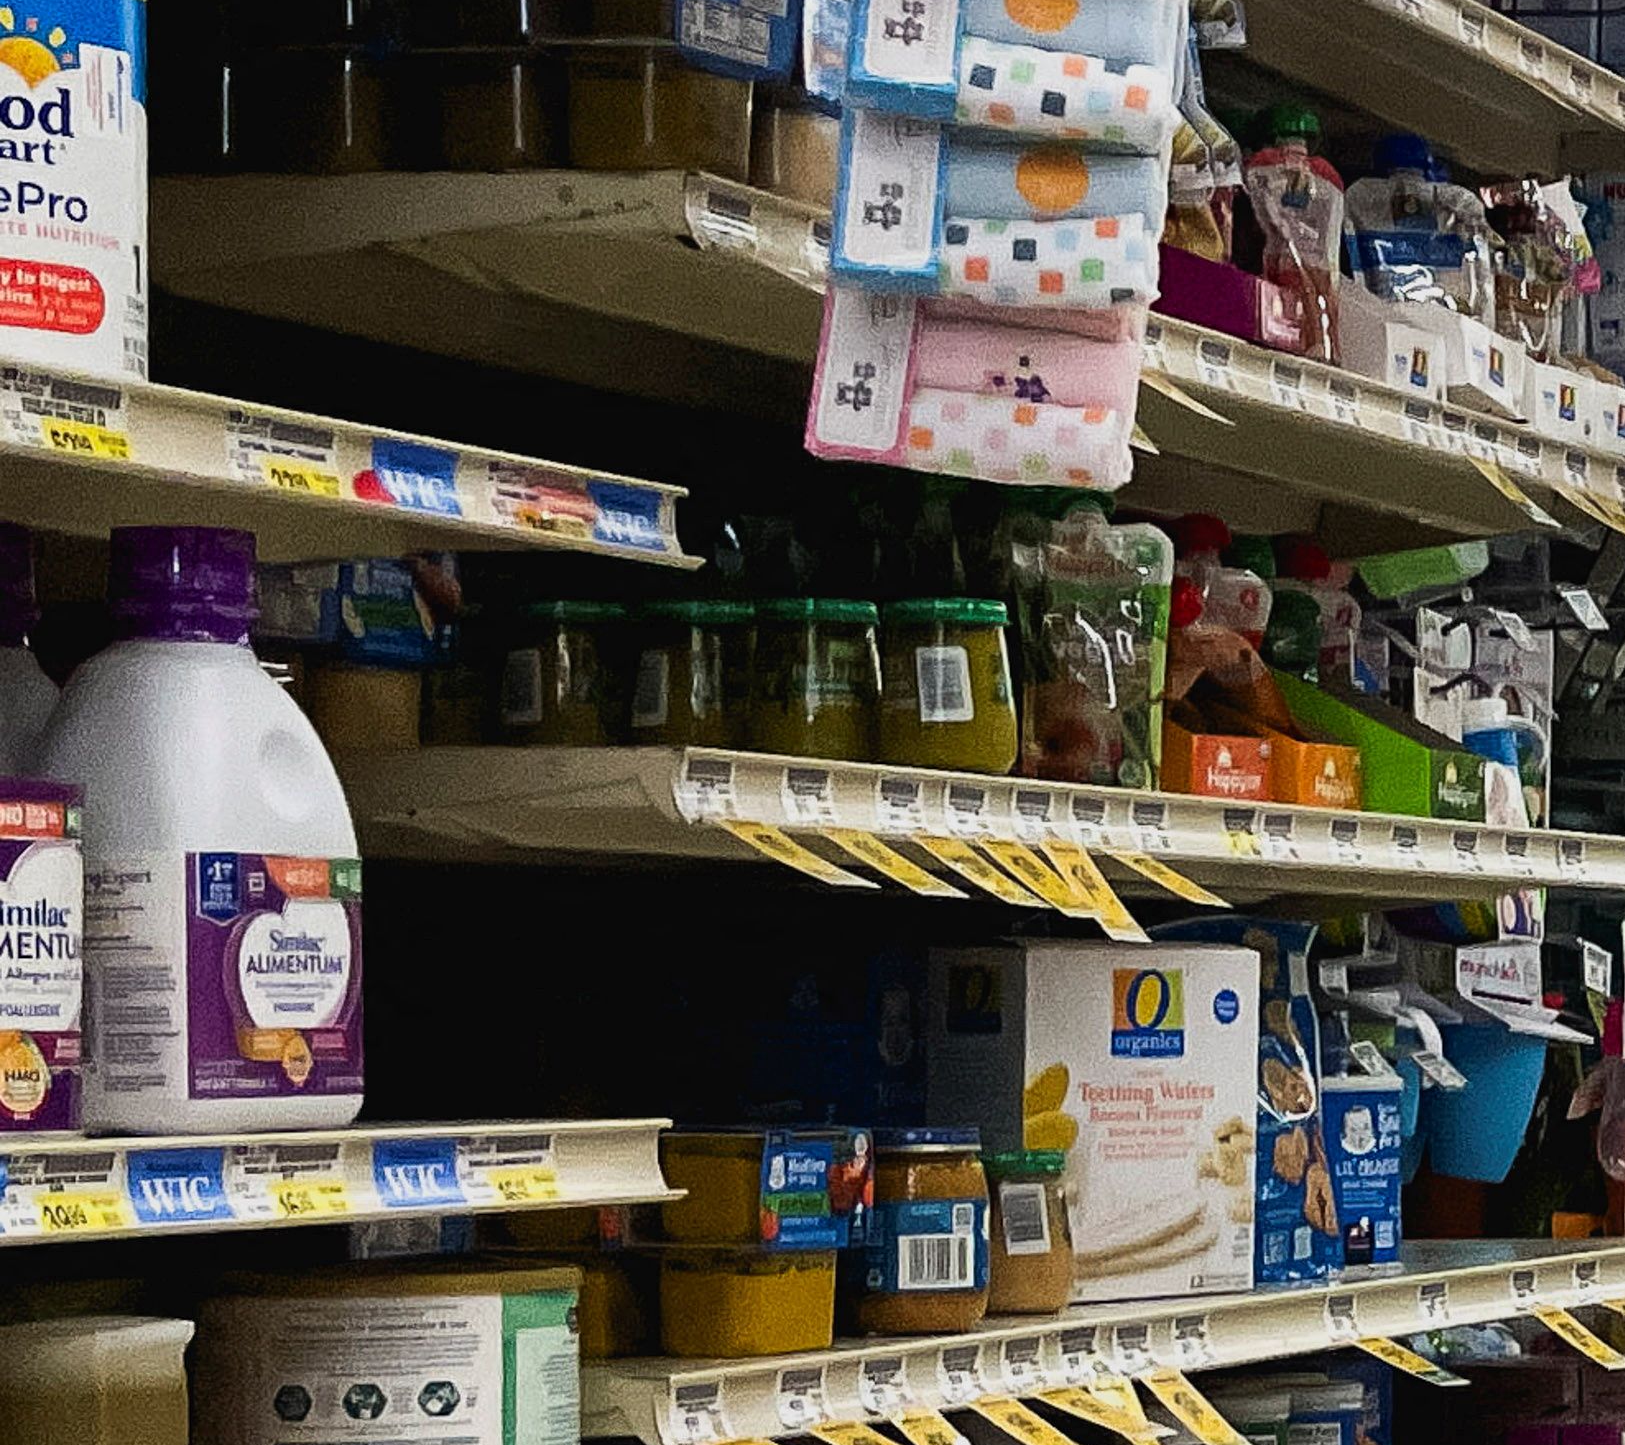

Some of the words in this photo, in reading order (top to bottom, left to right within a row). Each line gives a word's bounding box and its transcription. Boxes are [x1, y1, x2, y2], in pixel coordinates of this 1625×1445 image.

[269, 929, 325, 952] Similac
[246, 956, 344, 975] ALIMENTUM
[1114, 1032, 1182, 1053] organics
[1078, 1081, 1155, 1104] Teething
[382, 1161, 461, 1201] WIC
[140, 1176, 219, 1215] WIC
